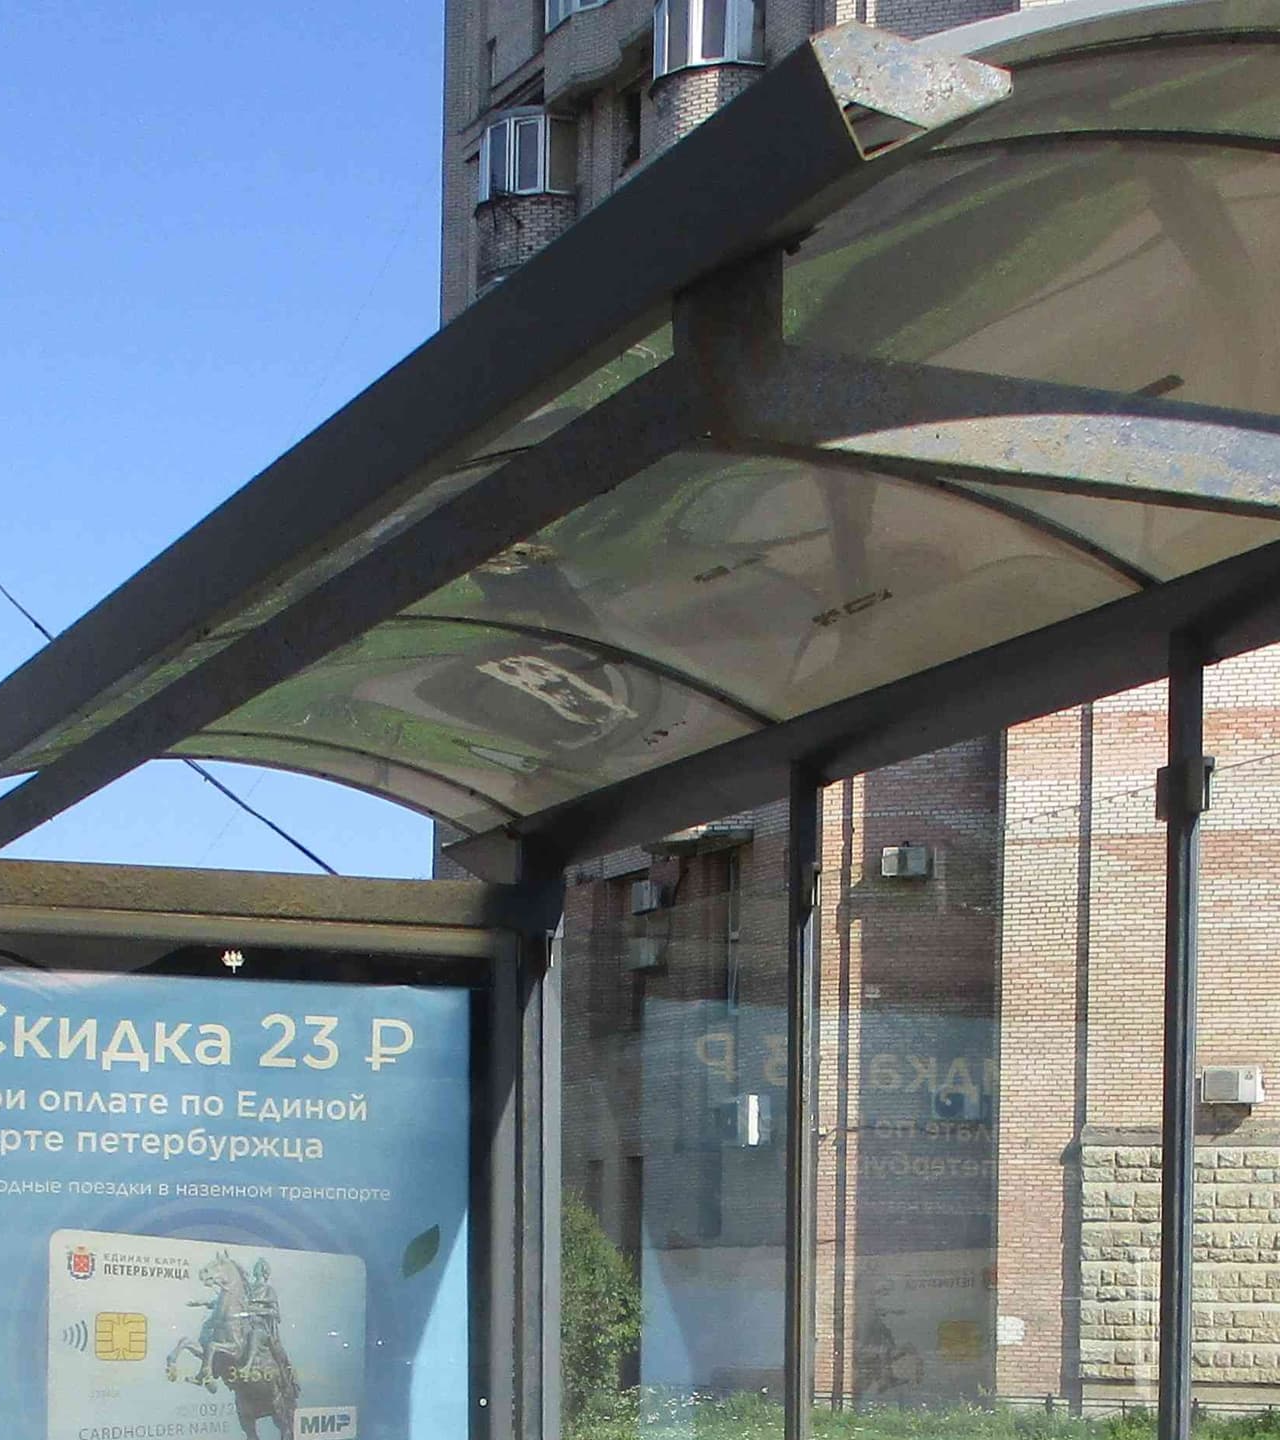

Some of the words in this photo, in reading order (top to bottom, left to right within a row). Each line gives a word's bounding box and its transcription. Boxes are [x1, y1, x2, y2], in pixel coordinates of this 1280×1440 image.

[259, 1013, 340, 1069] 23
[39, 1089, 168, 1115] оплате
[181, 1094, 224, 1116] по
[238, 1090, 368, 1122] Единой
[77, 1128, 324, 1162] петербуржца
[68, 1180, 152, 1197] поездки
[159, 1183, 169, 1196] в
[176, 1183, 273, 1199] наземном
[279, 1185, 391, 1203] транспорте
[104, 1253, 149, 1264] ЕДИНАЯ
[154, 1256, 189, 1266] КАРТА
[104, 1264, 190, 1280] ПЕТЕРБУРЖЦА
[79, 1425, 183, 1440] CARDHOLDER
[189, 1421, 230, 1434] NAME
[300, 1414, 351, 1434] МИР
